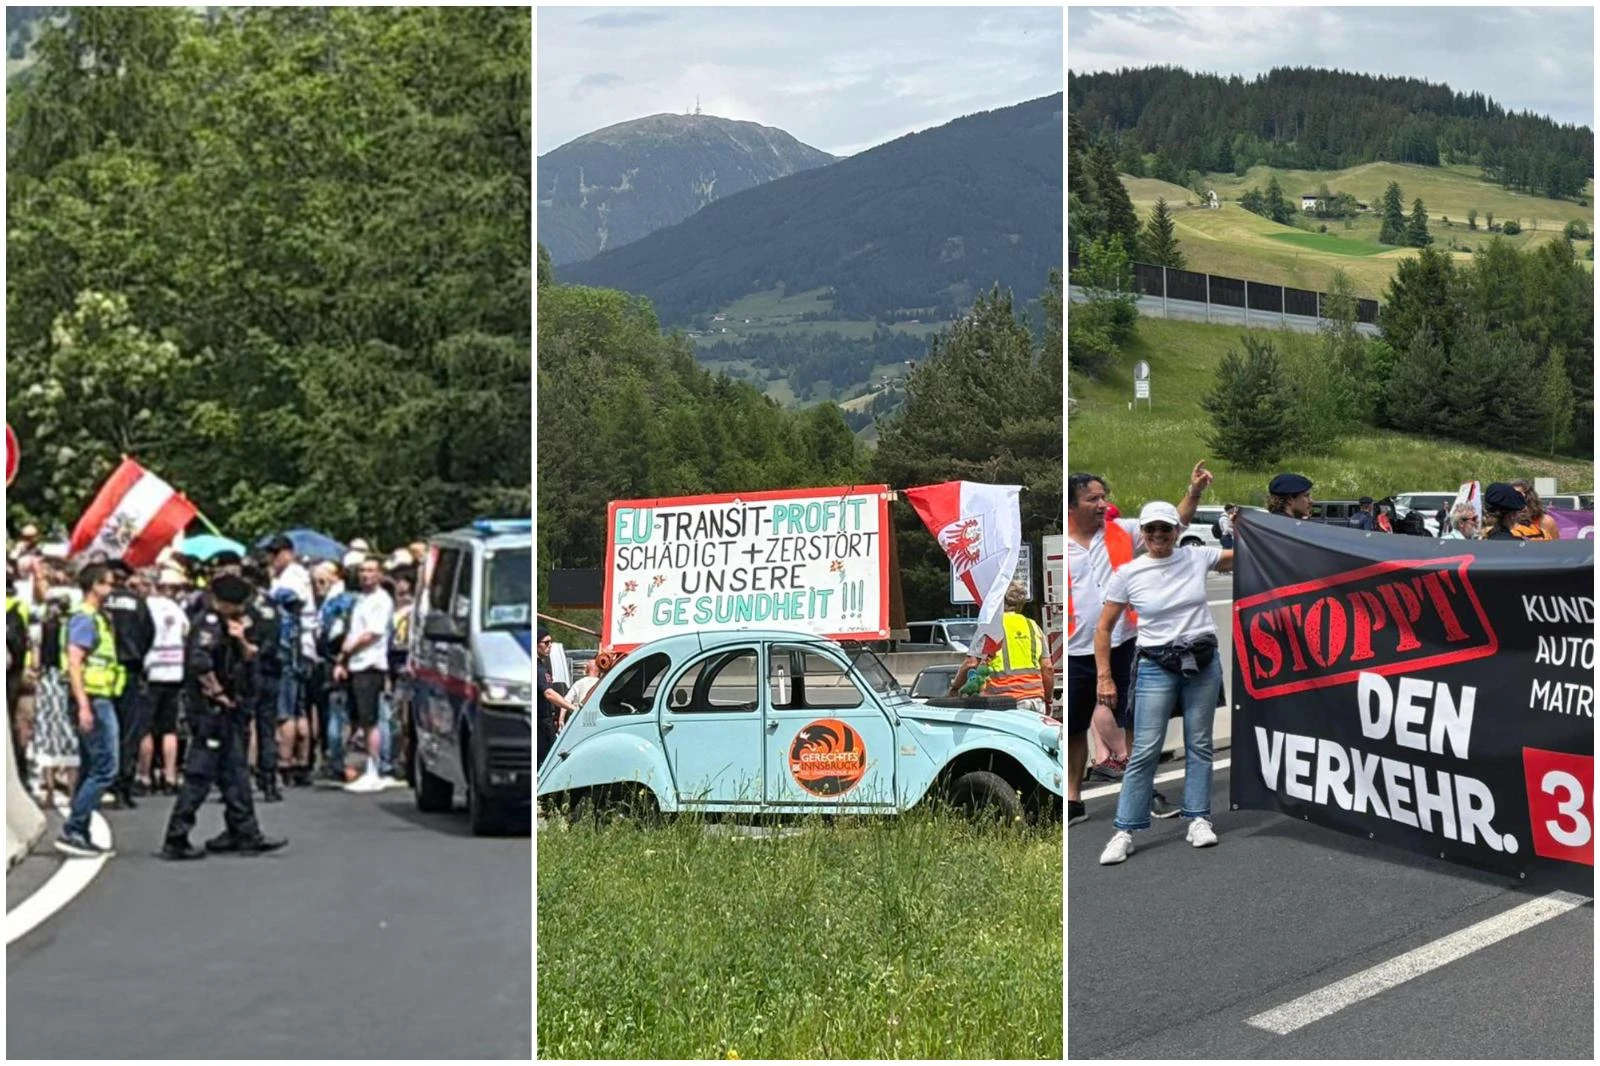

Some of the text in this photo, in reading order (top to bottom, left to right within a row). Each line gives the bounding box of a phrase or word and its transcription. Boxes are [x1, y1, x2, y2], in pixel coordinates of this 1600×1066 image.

[681, 564, 807, 594] UNSERE
[1250, 570, 1470, 679] STOPPT
[1535, 635, 1594, 669] AUTO
[1358, 671, 1477, 760] DEN
[801, 752, 859, 762] GERECHTES
[801, 761, 858, 770] INNSBRUCK
[1255, 726, 1519, 854] VERKEHR.
